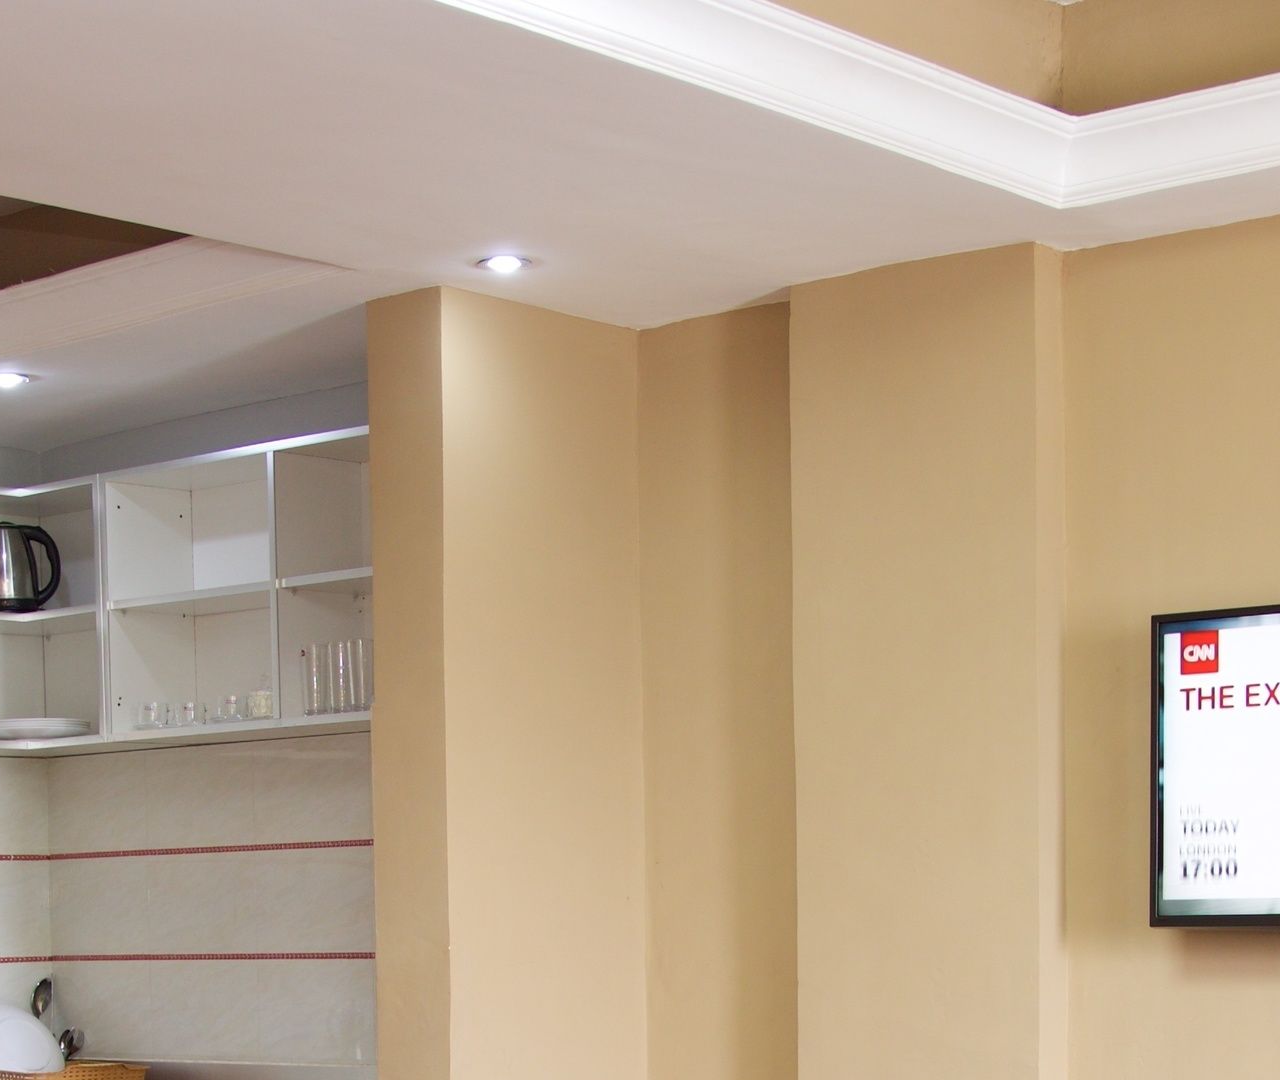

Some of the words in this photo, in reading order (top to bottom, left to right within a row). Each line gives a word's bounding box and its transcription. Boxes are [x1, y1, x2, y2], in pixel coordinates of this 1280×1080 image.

[1183, 643, 1215, 662] CNN
[1180, 685, 1234, 711] THE
[1180, 818, 1239, 836] TODAY
[1181, 857, 1238, 879] 17:00
